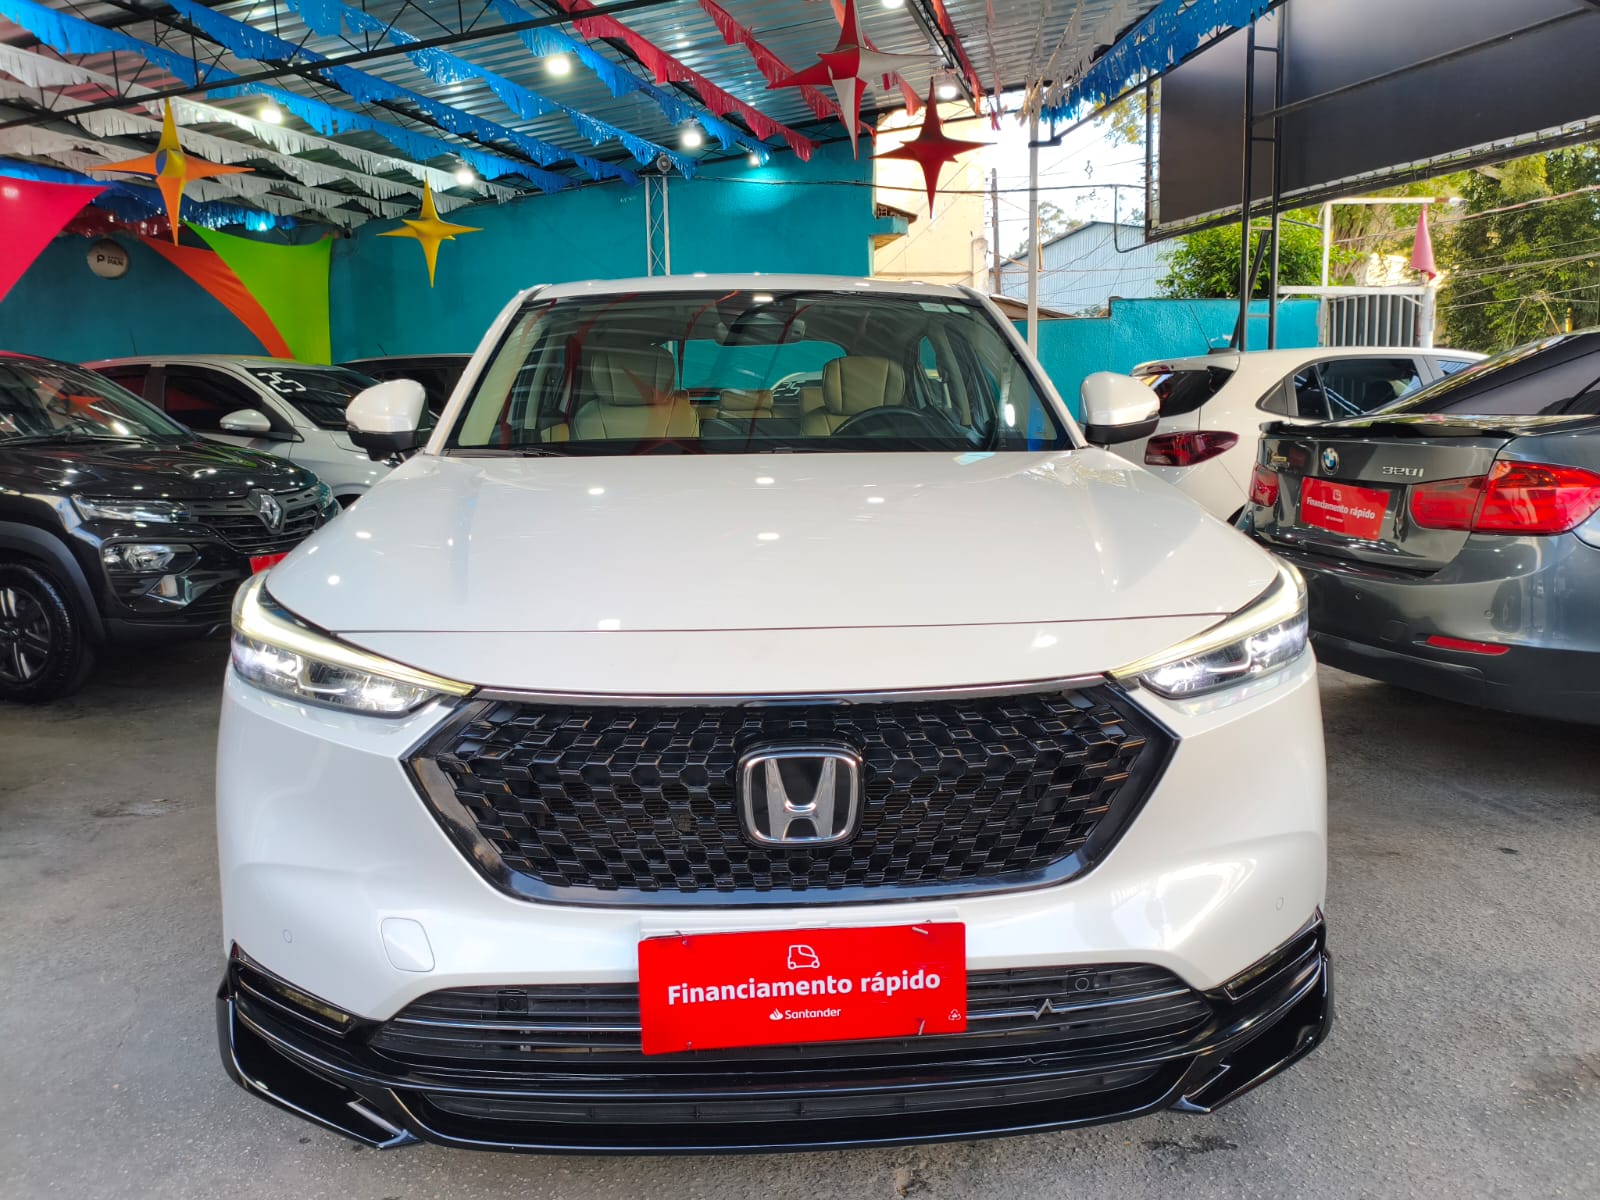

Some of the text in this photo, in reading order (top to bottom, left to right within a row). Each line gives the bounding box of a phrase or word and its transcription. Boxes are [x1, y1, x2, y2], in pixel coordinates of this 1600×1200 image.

[257, 372, 307, 393] 25
[1349, 506, 1376, 520] rápido
[668, 968, 941, 1005] Financiamento rápido
[784, 1007, 842, 1020] Santander
